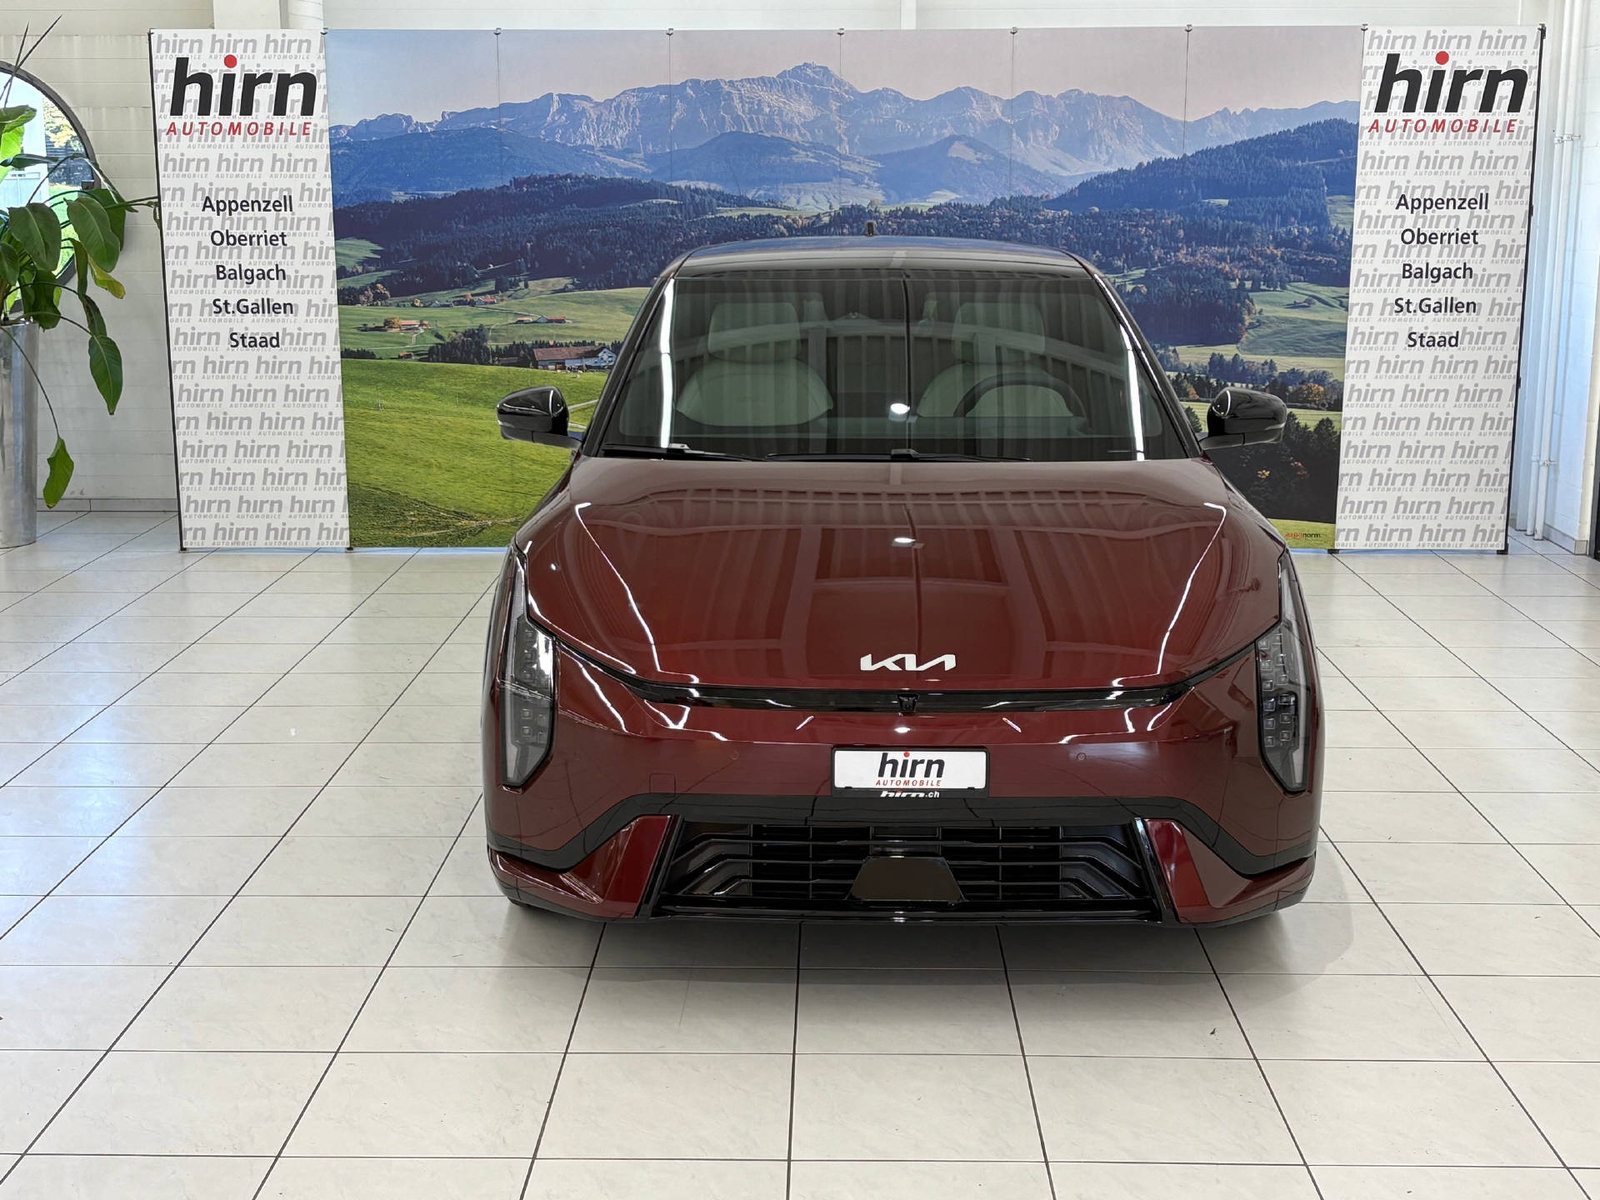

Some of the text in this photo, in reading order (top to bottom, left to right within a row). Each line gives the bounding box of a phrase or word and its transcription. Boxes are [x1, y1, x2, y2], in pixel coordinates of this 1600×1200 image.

[157, 33, 311, 53] hirn hirn hirn
[1368, 30, 1526, 49] hirn hirn hirn
[170, 54, 317, 116] hirn
[1374, 51, 1528, 113] hirn
[166, 122, 312, 136] AUTOMOBILE
[1368, 119, 1517, 133] AUTOMOBILE
[163, 153, 317, 172] hirn hirn hirn
[1361, 150, 1518, 169] hirn hirn hirn
[300, 183, 331, 200] hir
[1496, 180, 1529, 199] hir
[202, 195, 293, 216] Appenzell
[1395, 193, 1488, 214] Appenzell
[167, 212, 213, 230] hirn
[274, 212, 320, 230] hirn
[1358, 210, 1406, 228] hirn
[1467, 210, 1515, 228] hirn
[211, 230, 287, 246] Oberriet
[1401, 228, 1478, 245] Oberriet
[303, 241, 334, 259] hir
[1492, 239, 1525, 258] hir
[171, 270, 216, 288] hirn
[216, 264, 286, 284] Balgach
[1354, 268, 1401, 287] hirn
[1402, 263, 1473, 283] Balgach
[213, 298, 293, 314] St.Gallen
[306, 299, 337, 317] hir
[1394, 297, 1476, 313] St.Gallen
[1488, 298, 1521, 316] hir
[174, 327, 326, 345] hirn hirn
[230, 332, 280, 348] Staad
[1351, 326, 1507, 345] hirn hirn
[1408, 331, 1459, 347] Staad
[203, 356, 340, 373] hirn hirn hir
[1376, 355, 1518, 373] hirn hirn hir
[178, 383, 329, 402] hirn hirn hirn
[1348, 383, 1503, 402] hirn hirn hirn
[207, 412, 344, 430] hirn hirn hir
[1373, 412, 1513, 430] hirn hirn hir
[182, 440, 333, 458] hirn hirn hirn
[1344, 440, 1498, 458] hirn hirn hirn
[210, 467, 346, 485] hirn hirn hir
[1369, 468, 1509, 486] hirn hirn hir
[186, 495, 335, 513] hirn hirn hirn
[1341, 496, 1494, 514] hirn hirn hirn
[214, 522, 349, 540] hirn hirn hir
[1366, 524, 1504, 542] hirn hirn hir
[861, 654, 956, 671] KIA
[878, 752, 945, 778] hirn
